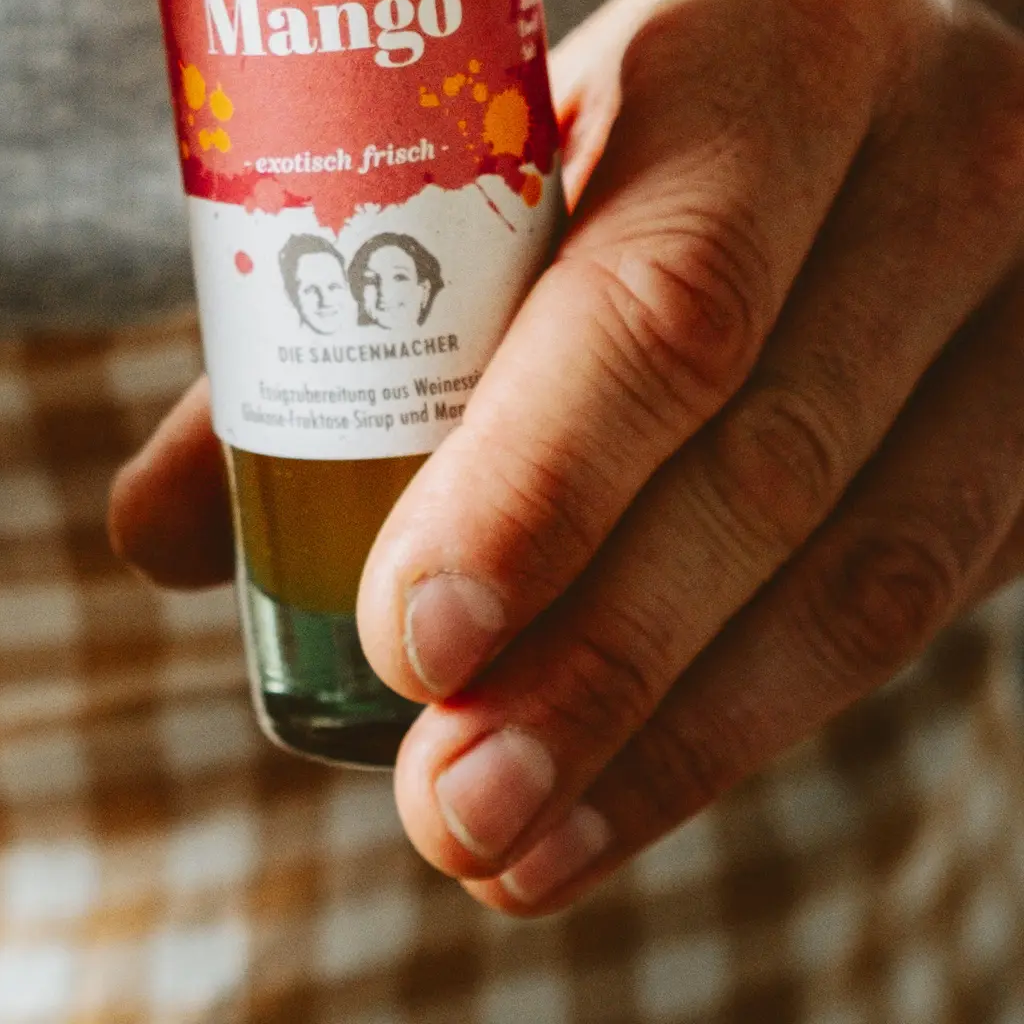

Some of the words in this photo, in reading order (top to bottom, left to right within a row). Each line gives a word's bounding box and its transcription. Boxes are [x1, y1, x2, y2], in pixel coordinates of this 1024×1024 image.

[256, 148, 352, 174] exotisch
[358, 139, 434, 174] frisch
[279, 346, 304, 364] DIE
[309, 333, 460, 364] SAUCENMACHER
[382, 385, 409, 401] aus
[413, 370, 481, 397] Weinessi
[353, 409, 394, 432] Sirup
[400, 402, 429, 425] und
